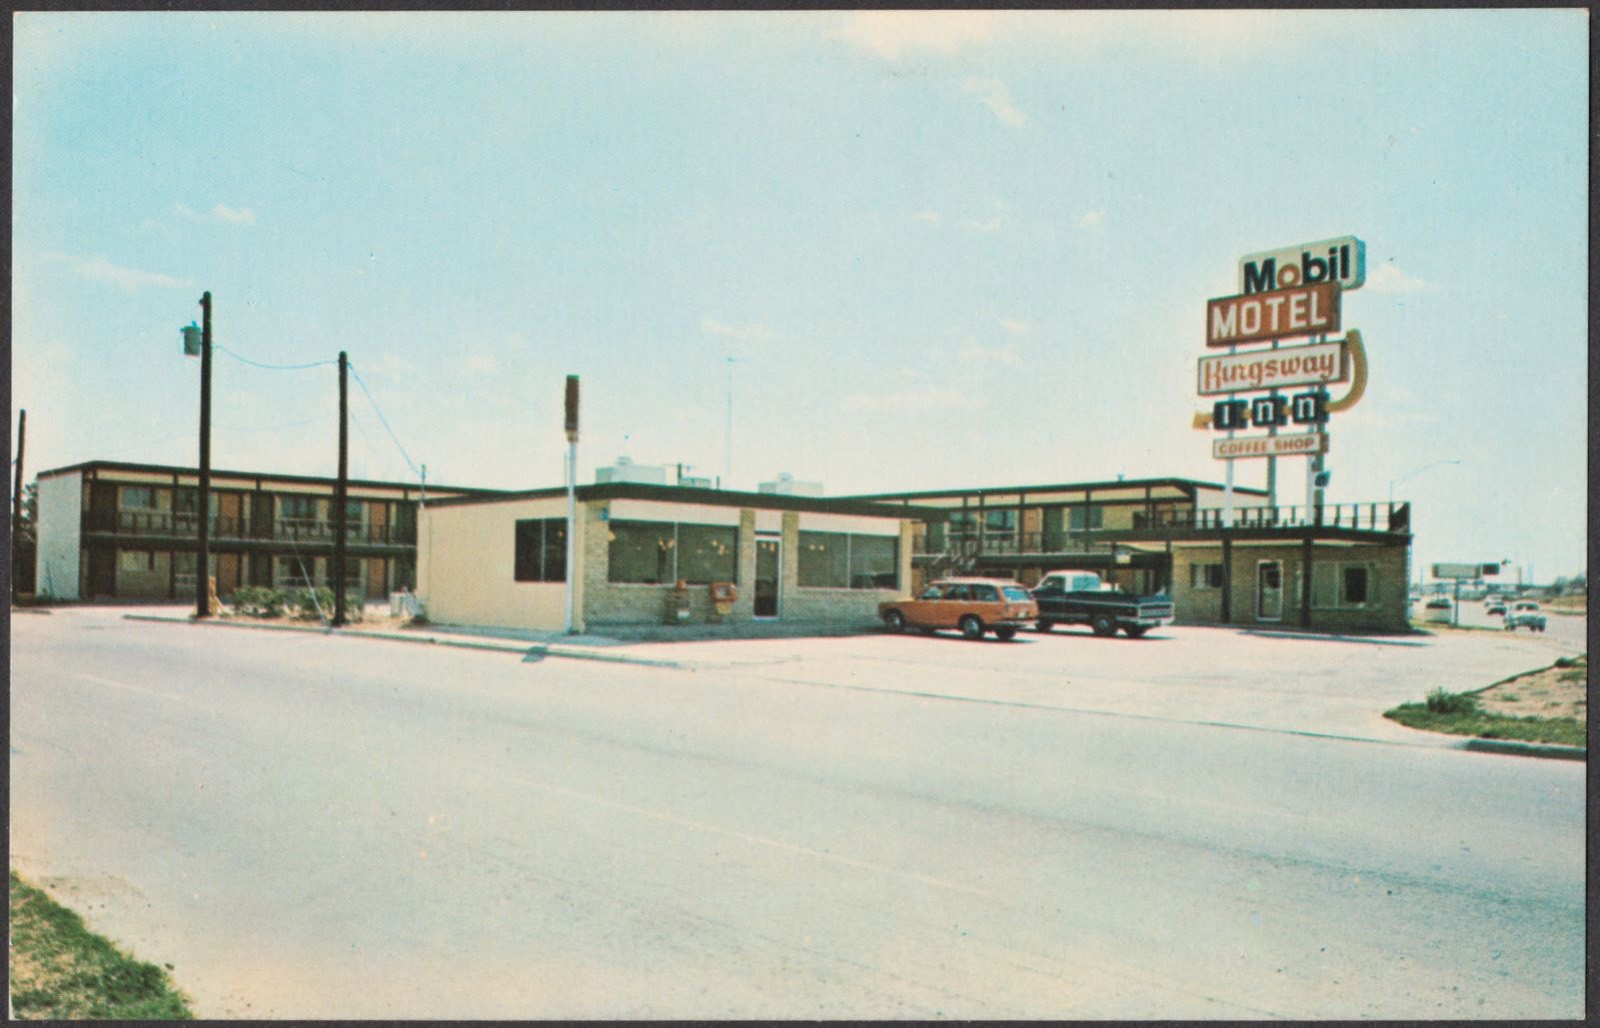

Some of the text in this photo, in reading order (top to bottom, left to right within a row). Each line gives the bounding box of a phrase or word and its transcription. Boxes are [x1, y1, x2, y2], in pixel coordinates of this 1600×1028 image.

[1243, 244, 1350, 294] Mobil
[1212, 290, 1327, 339] MOTEL
[1204, 352, 1335, 391] Kingsway
[1219, 438, 1315, 455] COFFEE SHOP
